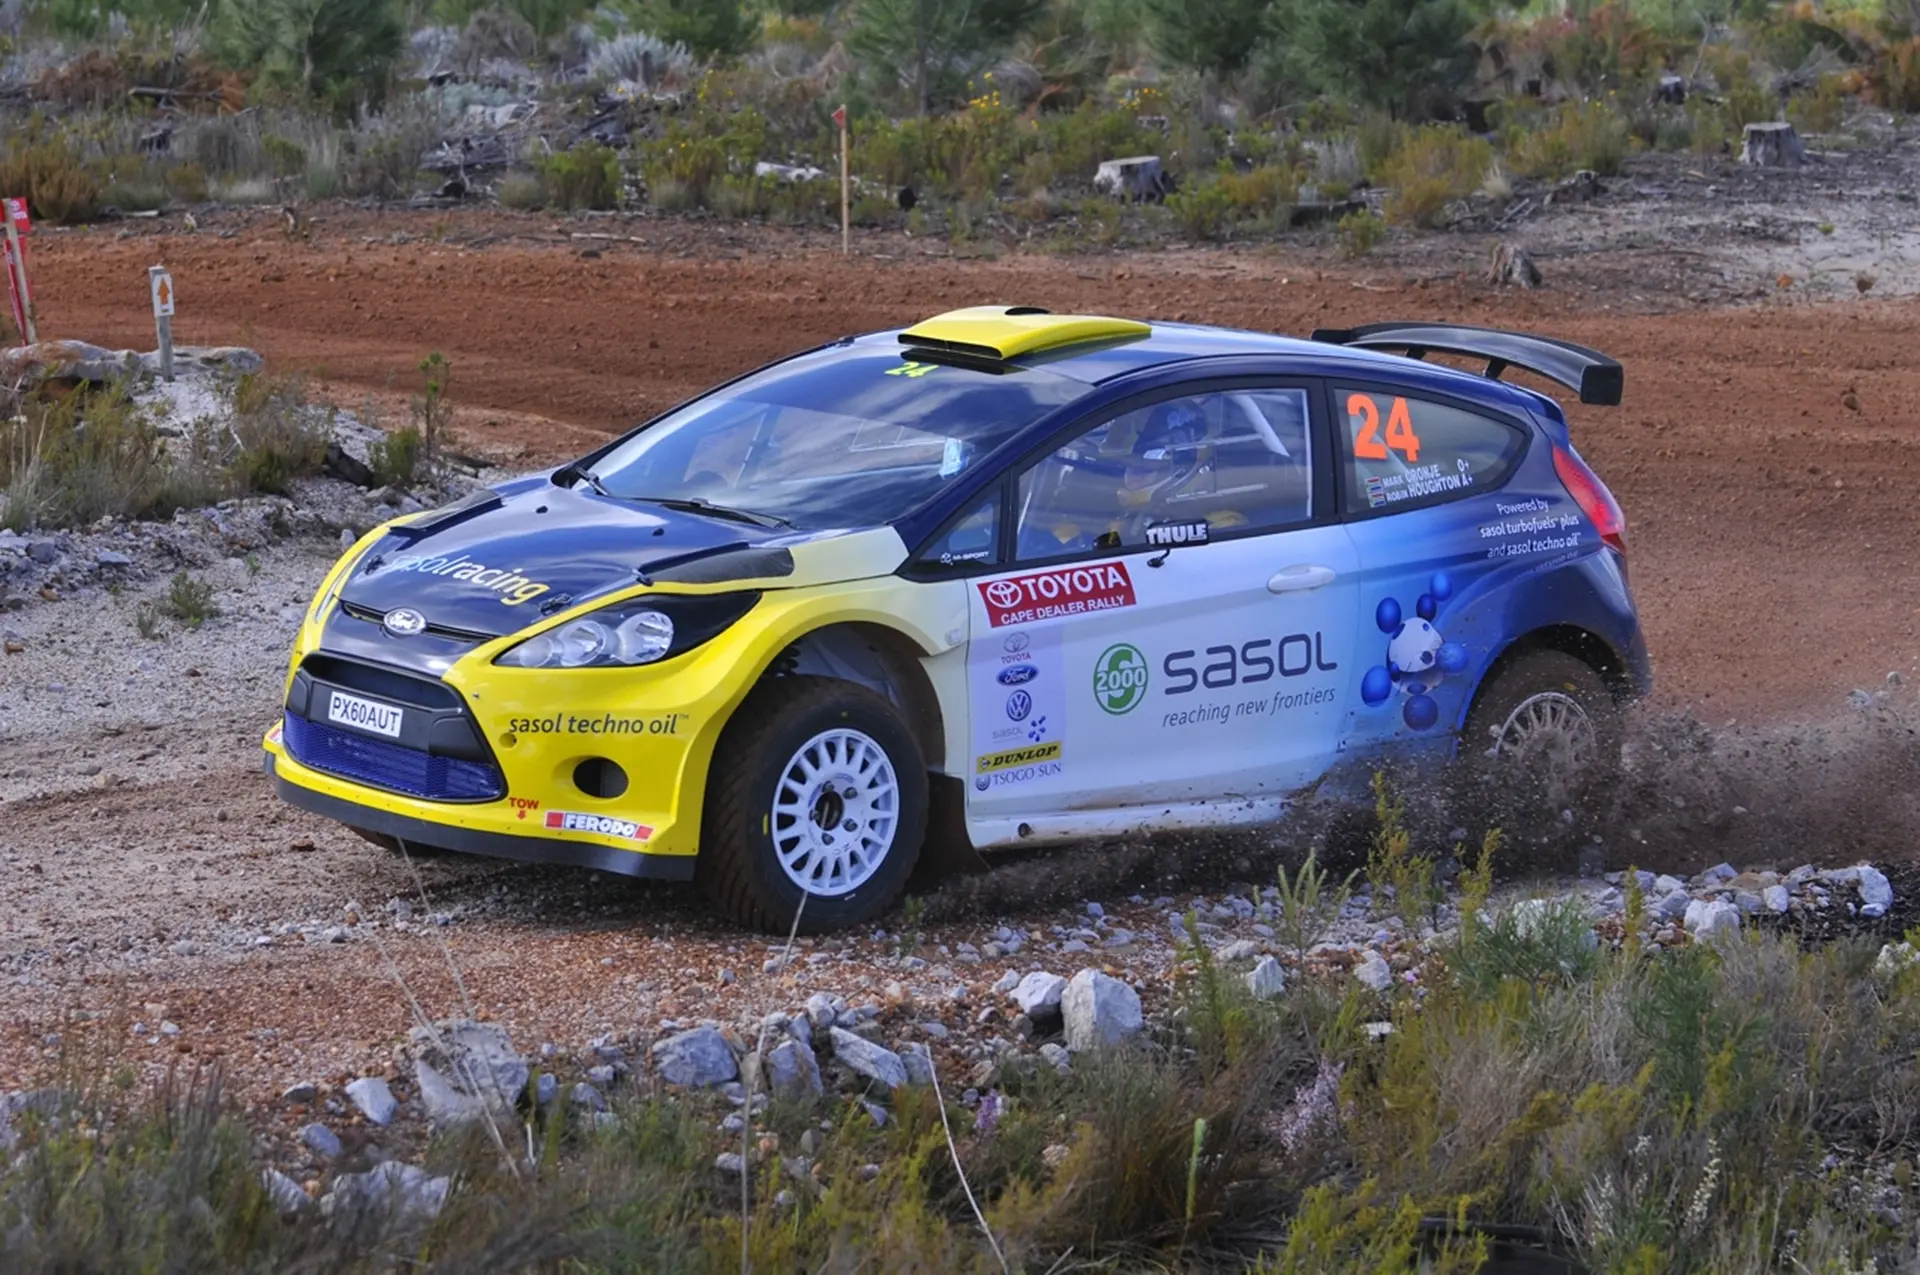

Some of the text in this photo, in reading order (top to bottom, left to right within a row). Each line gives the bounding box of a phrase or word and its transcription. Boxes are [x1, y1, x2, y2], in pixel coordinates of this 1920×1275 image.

[1347, 393, 1420, 462] 24
[1408, 474, 1460, 497] HOUGHTON
[1496, 498, 1549, 515] Powered by
[1146, 523, 1207, 545] THULE
[1480, 521, 1506, 538] sasol
[1560, 512, 1579, 531] plus
[1487, 542, 1506, 559] and
[1507, 539, 1531, 556] sasol
[1532, 535, 1564, 552] techno
[1021, 565, 1127, 601] TOYOTA
[1001, 594, 1125, 625] CAPE DEALER RALLY
[1001, 652, 1031, 664] TOYOTA
[1096, 666, 1146, 692] 2000
[332, 696, 400, 732] PX60AUT
[1162, 686, 1336, 728] reaching new frontiers
[508, 713, 562, 733] sasol
[568, 714, 644, 733] techno
[992, 746, 1058, 767] DUNLOP
[992, 762, 1062, 786] TSOGO SUN
[509, 797, 540, 810] TOW
[564, 813, 636, 837] FERODO
